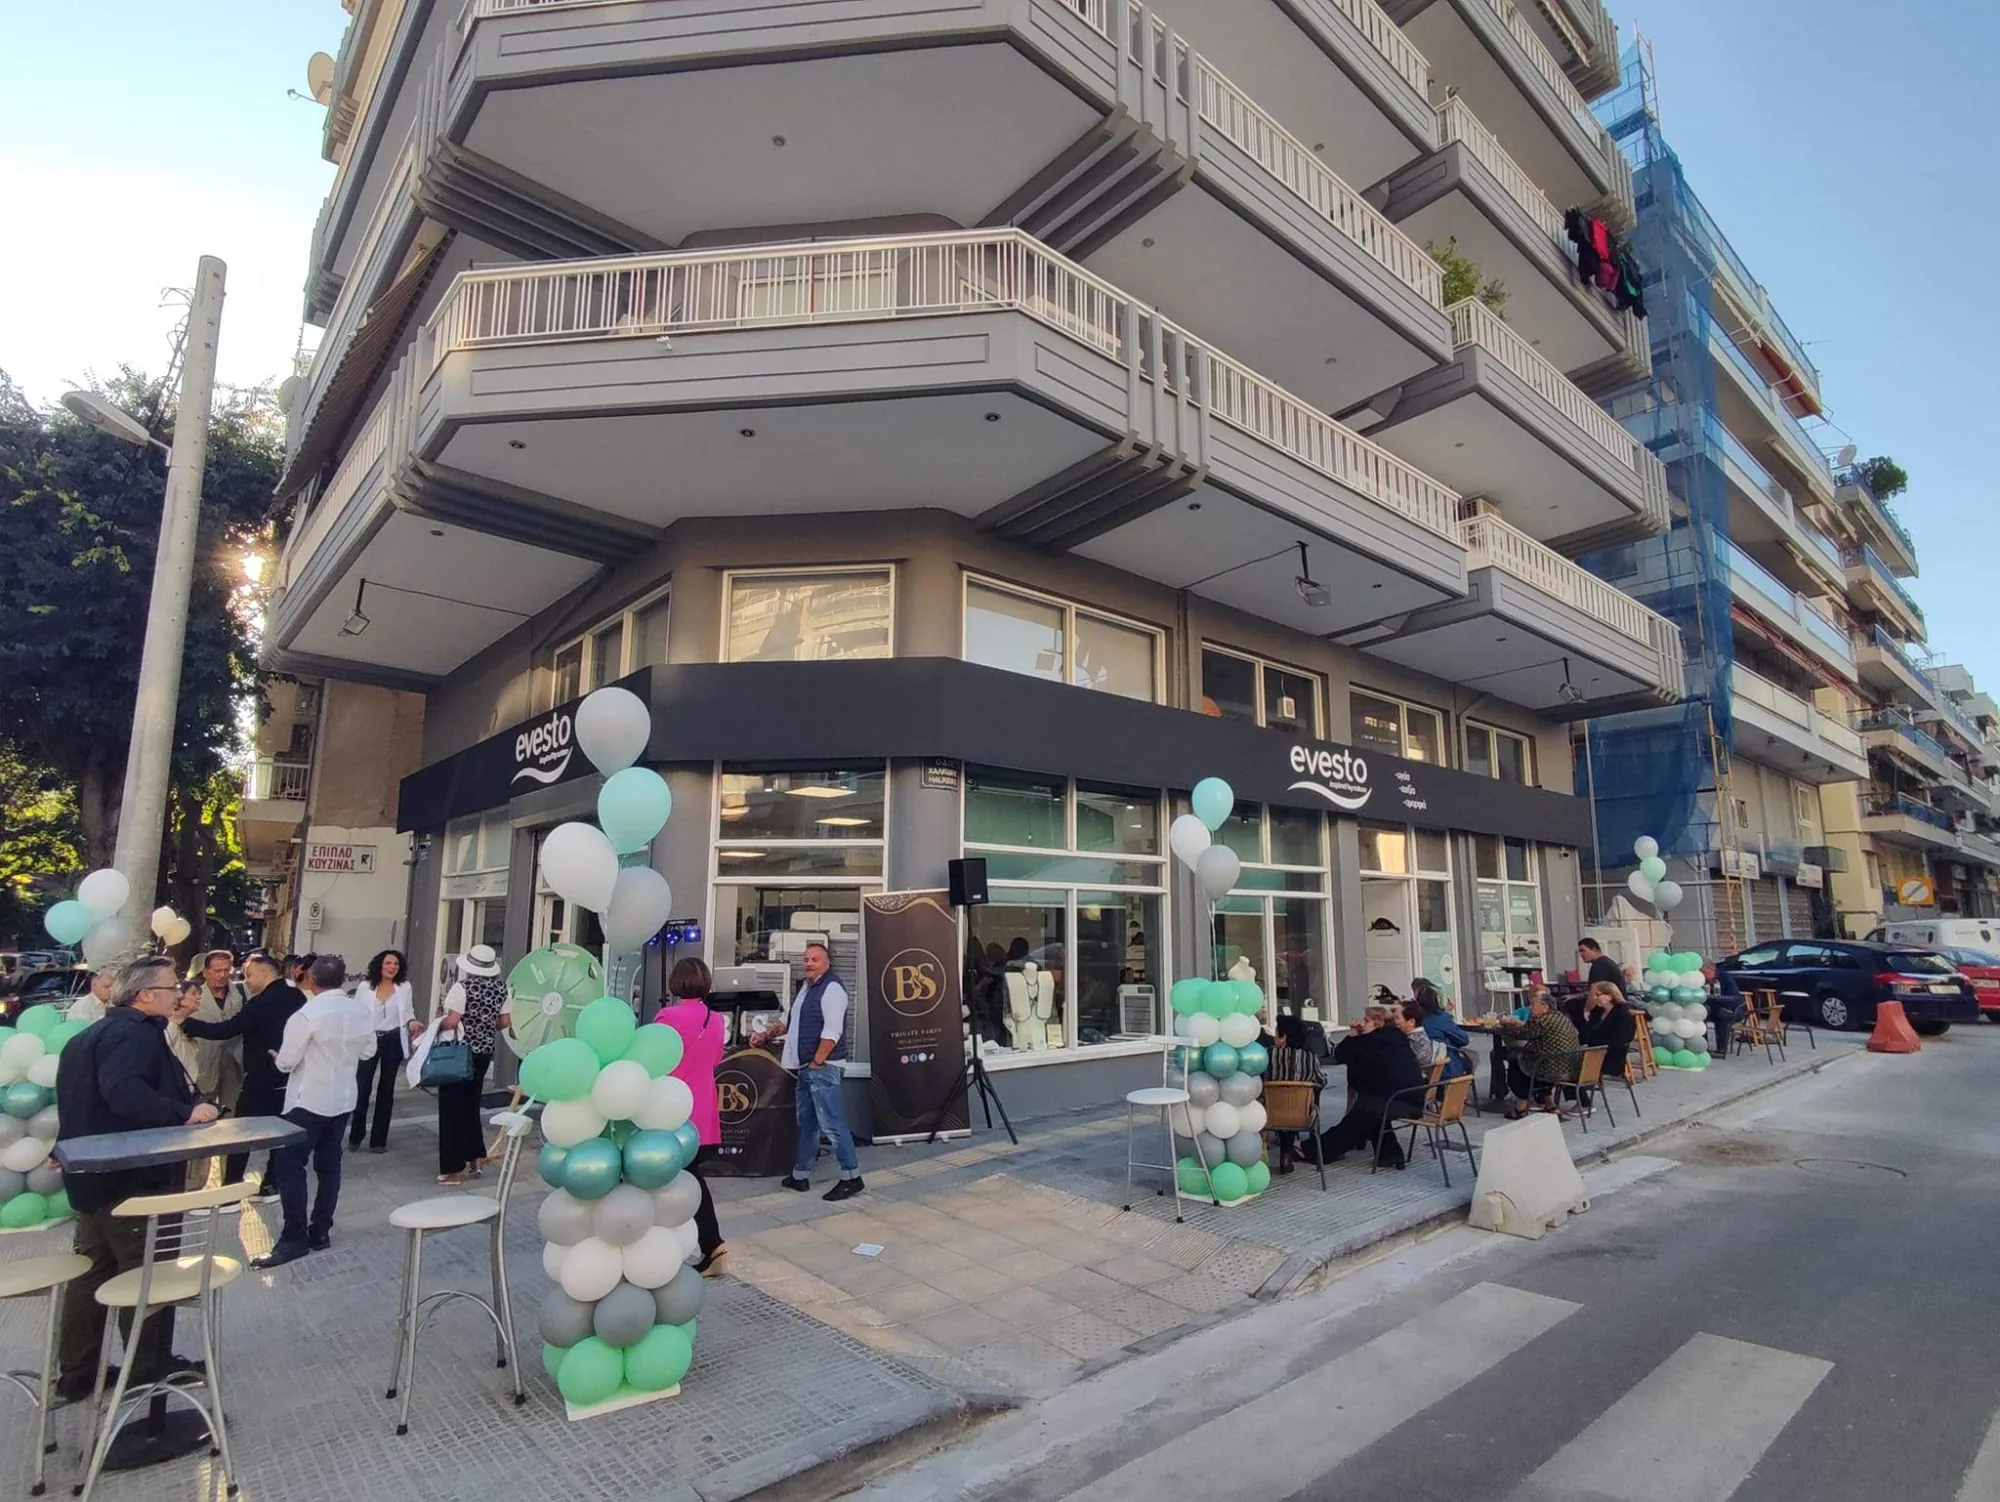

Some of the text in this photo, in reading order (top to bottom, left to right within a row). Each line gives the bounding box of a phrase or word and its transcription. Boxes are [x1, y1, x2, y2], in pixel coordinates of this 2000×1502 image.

[516, 712, 571, 762] evesto
[1290, 745, 1368, 783] evesto
[312, 846, 353, 858] ΕΠΙΠΛΟ
[308, 858, 356, 871] ΚΟΥΖΙΝΑΣ
[891, 1030, 918, 1038] PRIVATE
